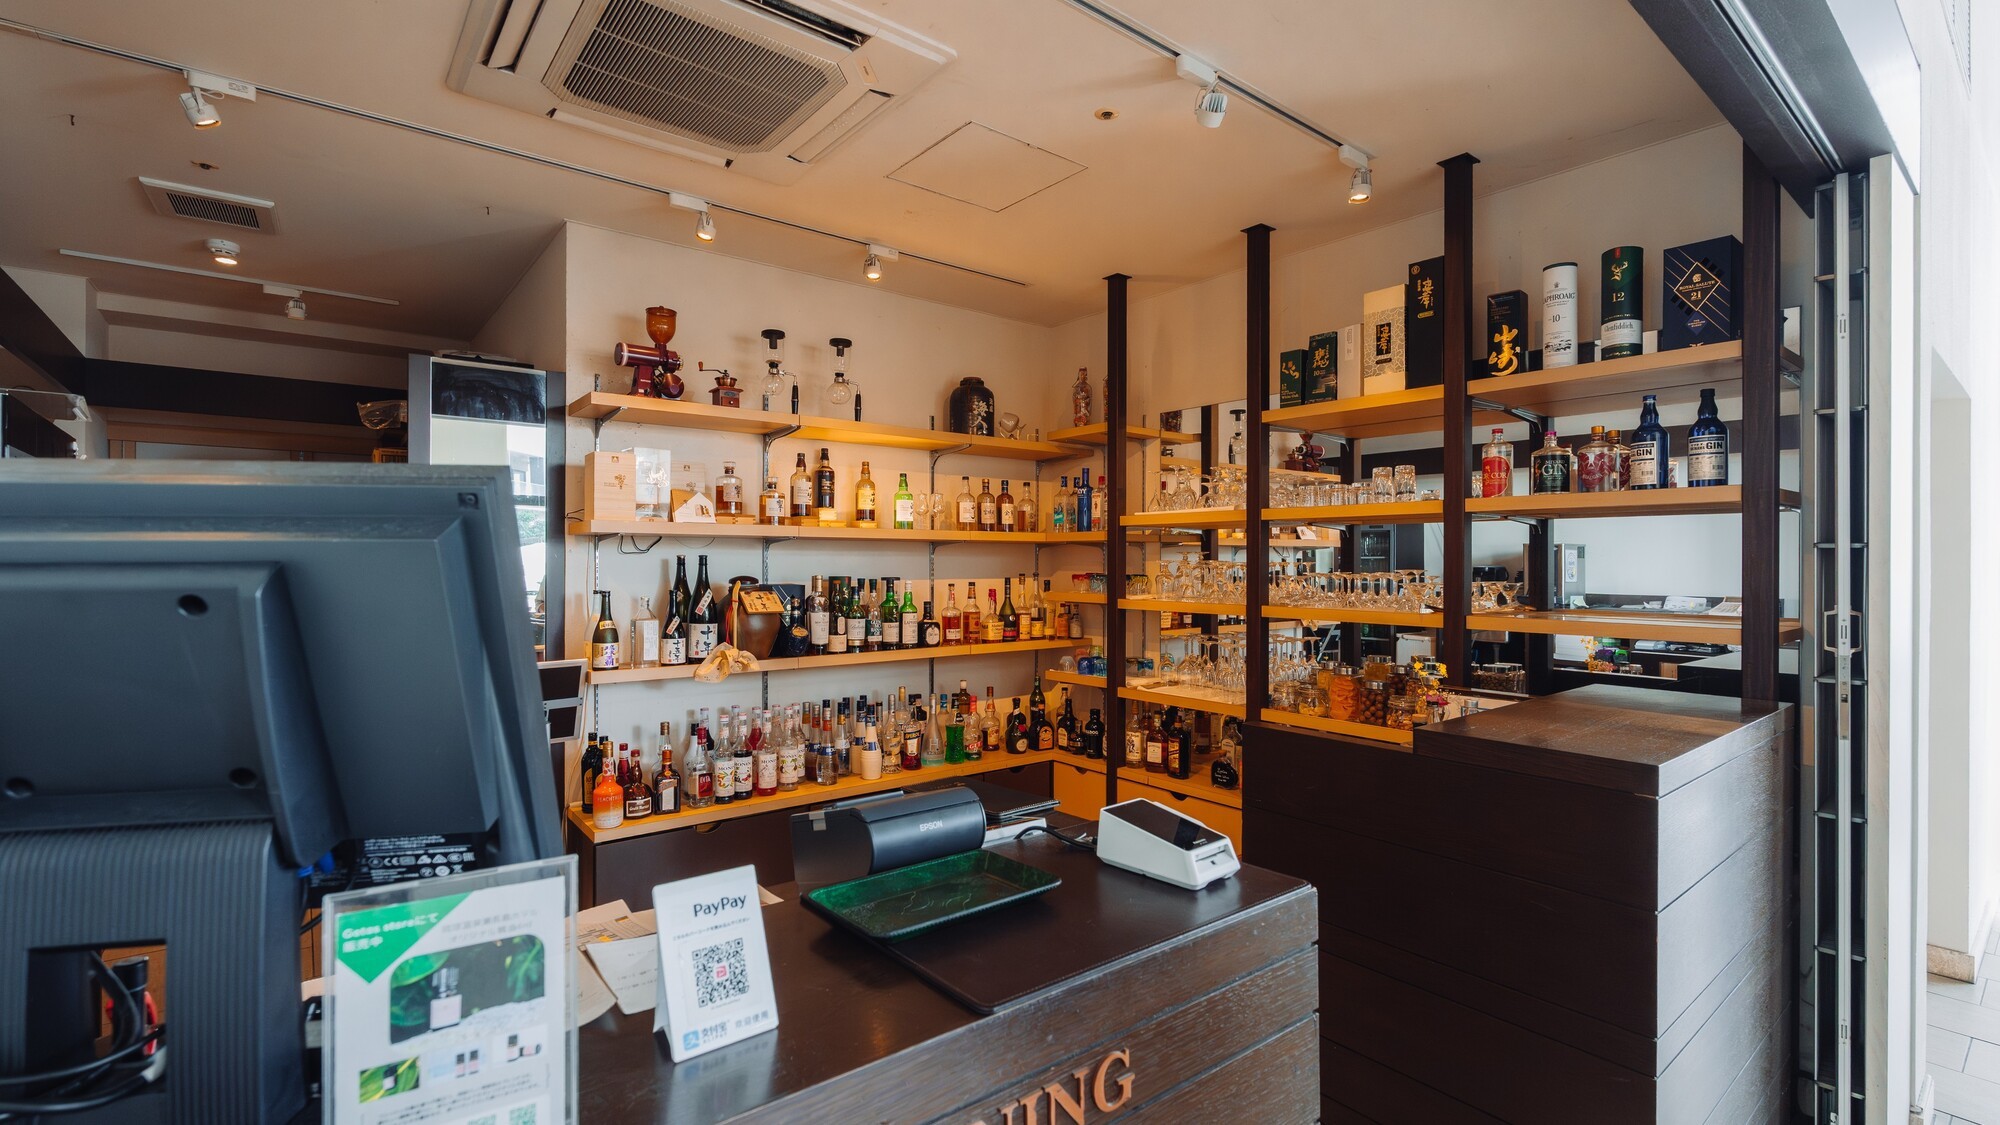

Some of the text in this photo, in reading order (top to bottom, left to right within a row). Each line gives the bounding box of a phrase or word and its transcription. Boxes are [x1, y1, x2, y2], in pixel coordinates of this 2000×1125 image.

[1611, 291, 1625, 303] 12
[1691, 291, 1702, 300] 21
[1552, 314, 1561, 323] 10
[1705, 441, 1723, 450] GIN
[1636, 448, 1652, 457] GIN
[1542, 464, 1567, 476] GIN
[919, 819, 944, 832] EPSON
[693, 895, 746, 917] PayPay
[701, 1021, 727, 1038] 支付宝
